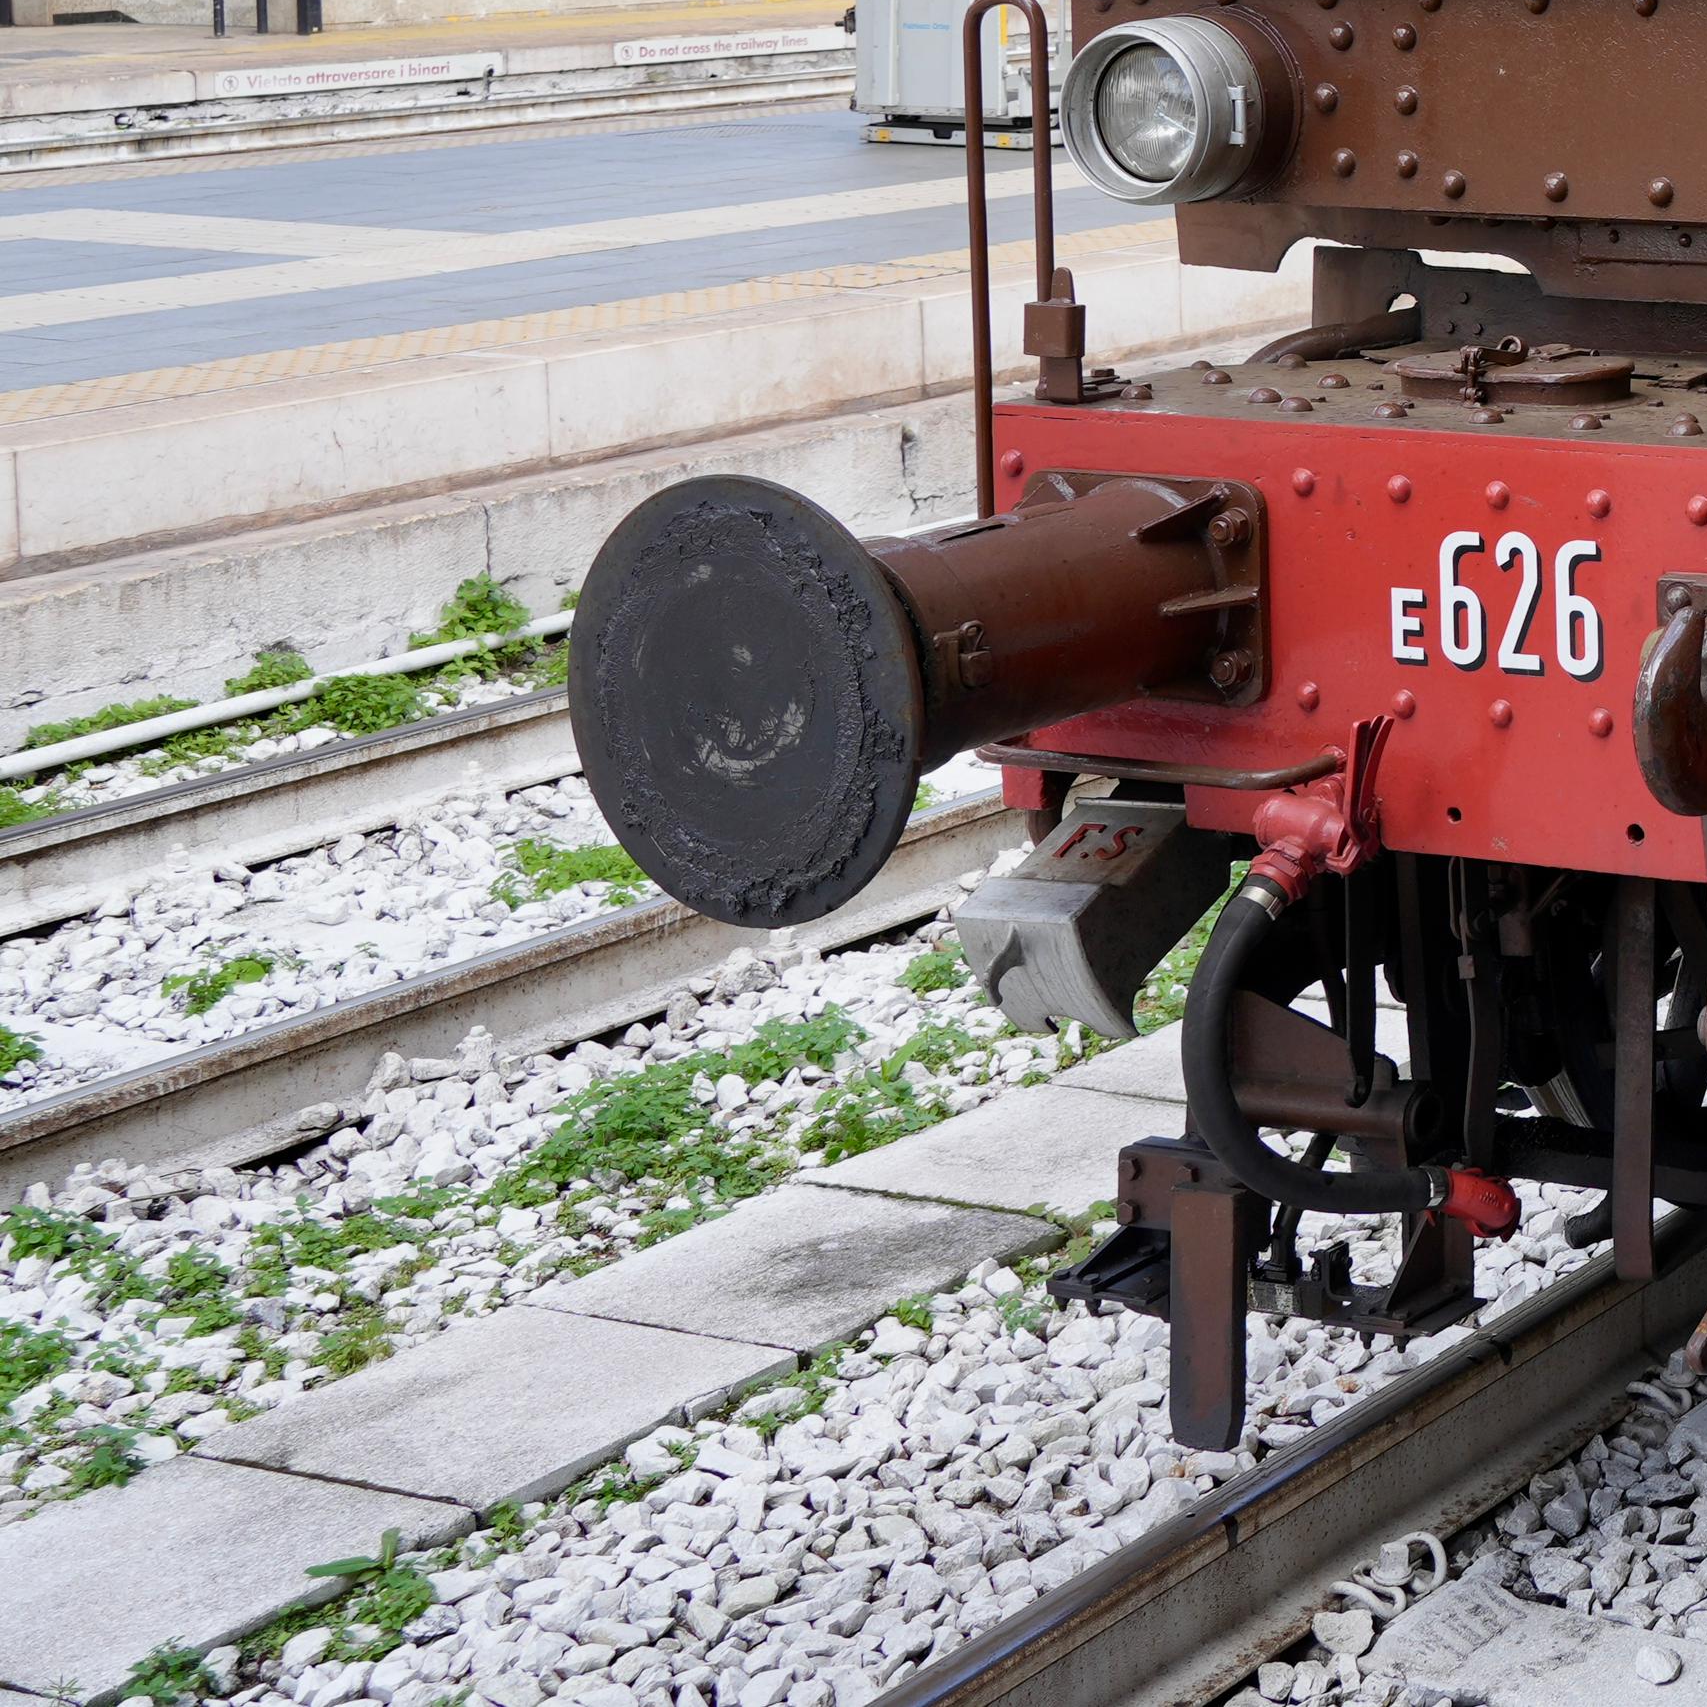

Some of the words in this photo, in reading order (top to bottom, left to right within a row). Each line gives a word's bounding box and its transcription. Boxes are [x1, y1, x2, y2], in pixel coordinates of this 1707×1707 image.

[639, 46, 655, 58] Do
[660, 46, 678, 57] not
[682, 45, 711, 56] cross
[714, 40, 732, 53] the
[736, 37, 778, 52] railway
[782, 35, 808, 48] lines
[247, 74, 301, 90] Vietato
[306, 68, 396, 85] attraversare
[408, 61, 450, 76] binari
